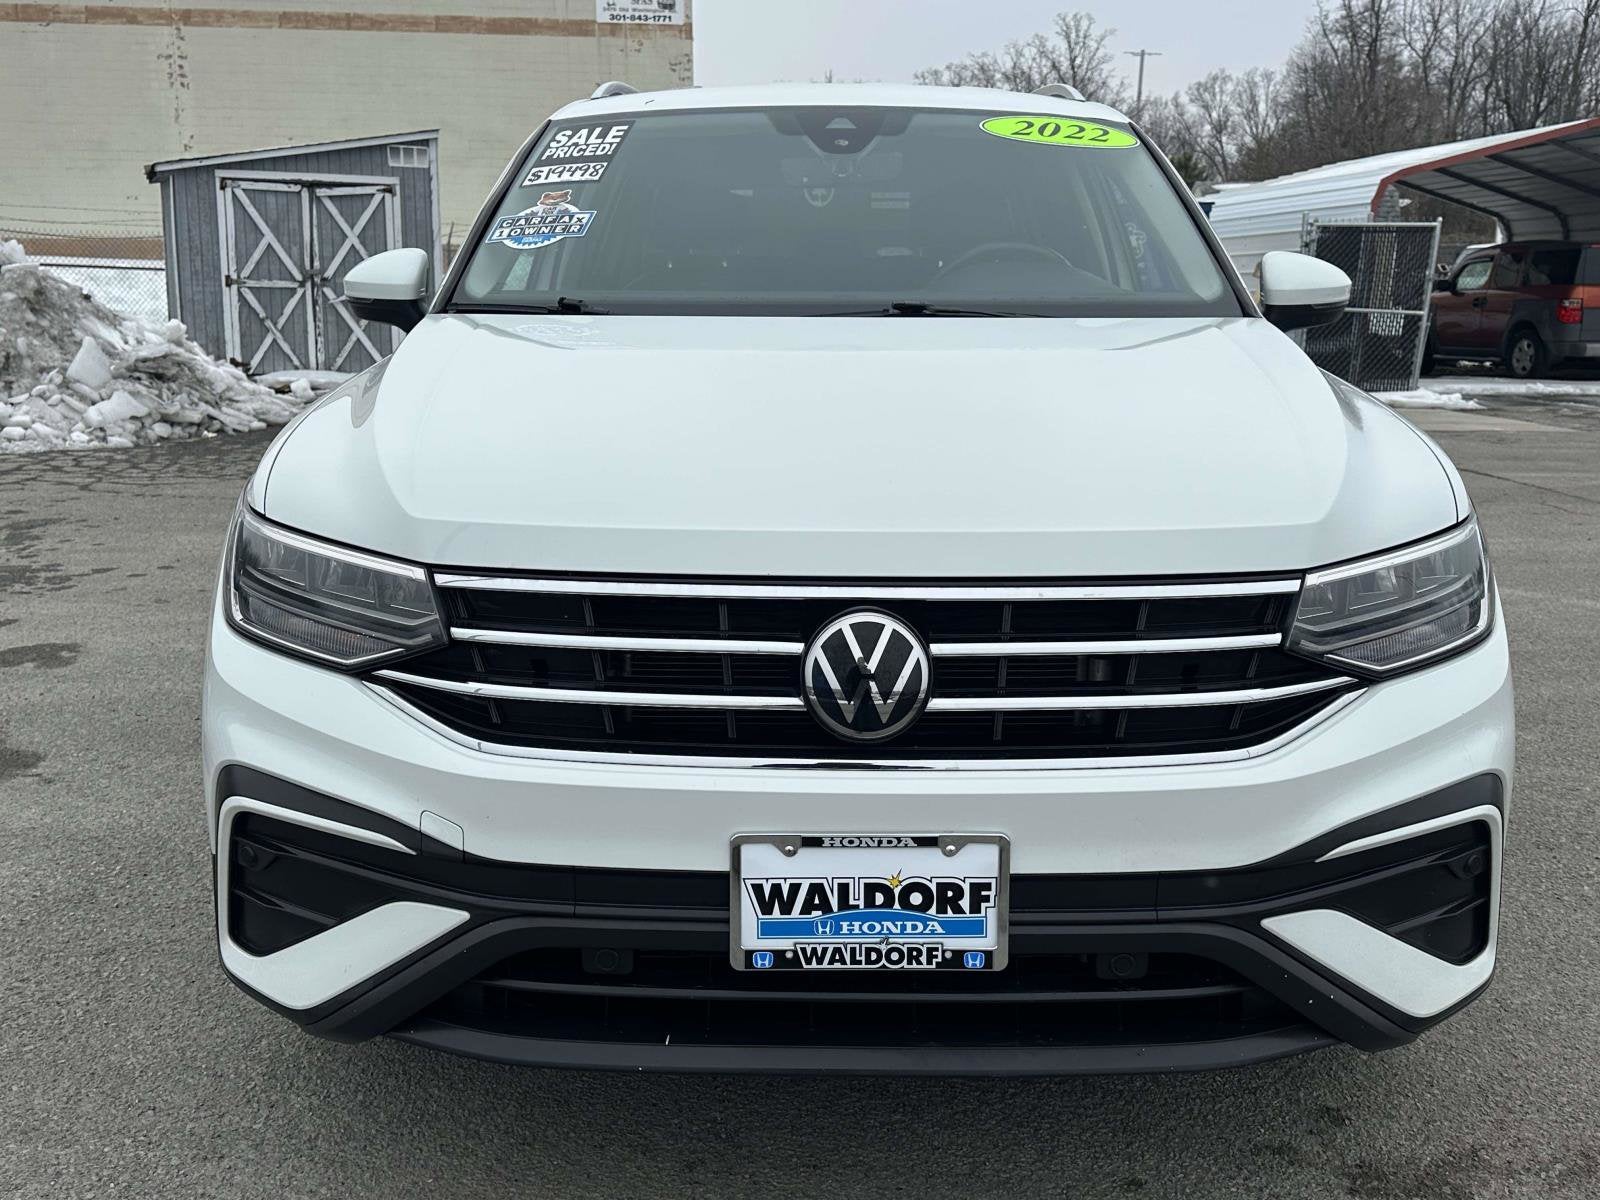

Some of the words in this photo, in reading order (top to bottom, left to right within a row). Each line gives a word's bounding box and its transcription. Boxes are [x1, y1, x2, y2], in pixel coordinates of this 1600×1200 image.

[609, 13, 672, 22] 301-843-1771
[550, 125, 629, 148] SALE
[1011, 120, 1110, 142] 2022
[541, 143, 617, 160] PRICED!
[501, 214, 587, 228] CARFAX
[510, 224, 581, 237] OWNER
[821, 836, 917, 848] HONDA
[750, 881, 993, 916] WALDORF
[839, 920, 945, 935] HONDA
[799, 945, 940, 966] WALDORF
